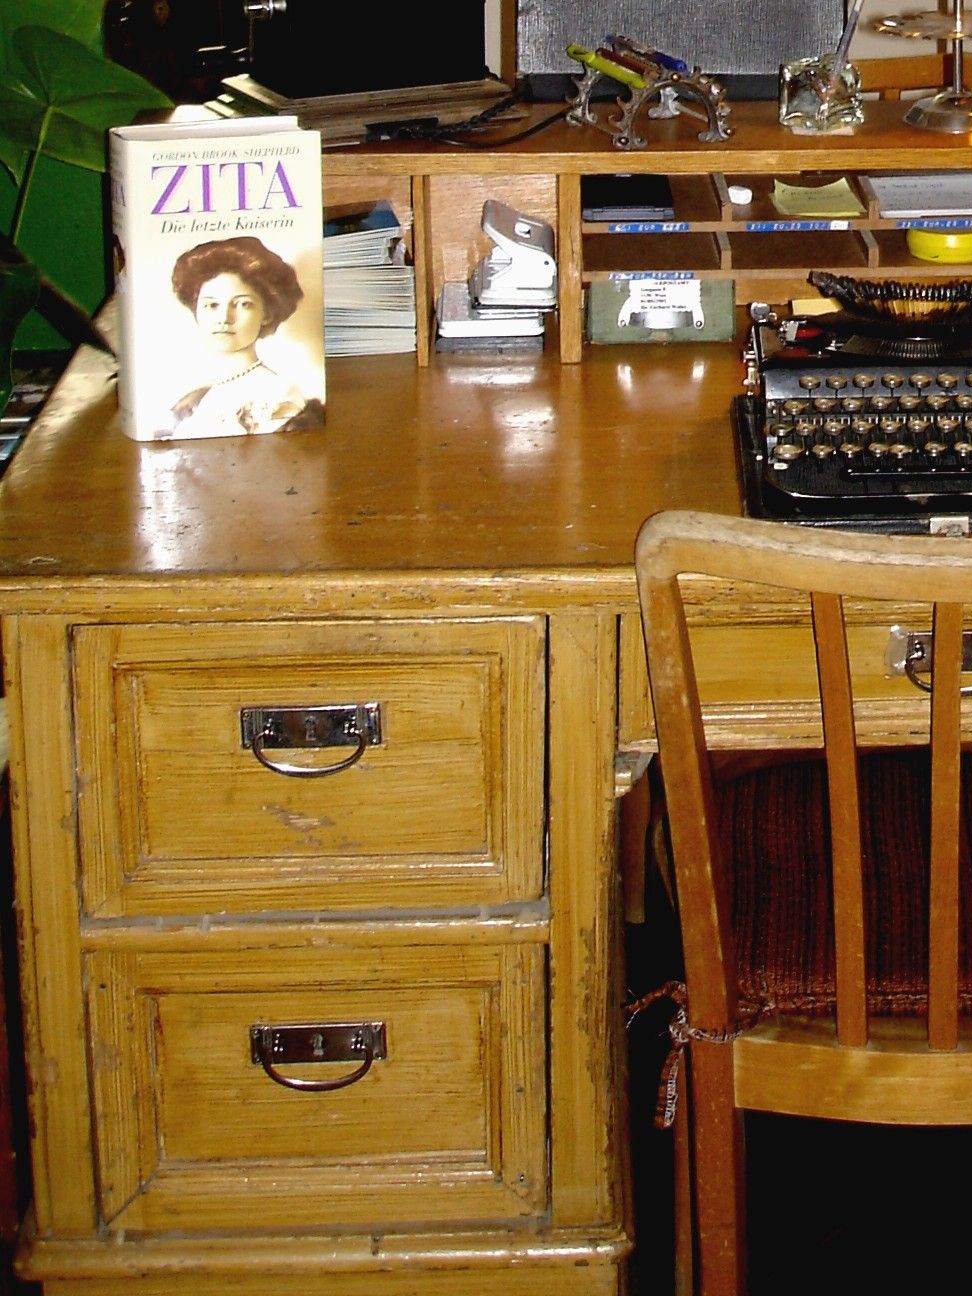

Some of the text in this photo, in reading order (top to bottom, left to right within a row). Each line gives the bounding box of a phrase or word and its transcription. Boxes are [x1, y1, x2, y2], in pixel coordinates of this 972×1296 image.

[152, 151, 198, 161] GORDON
[151, 160, 303, 215] ZITA
[161, 215, 294, 234] Die letzte Kaiserin
